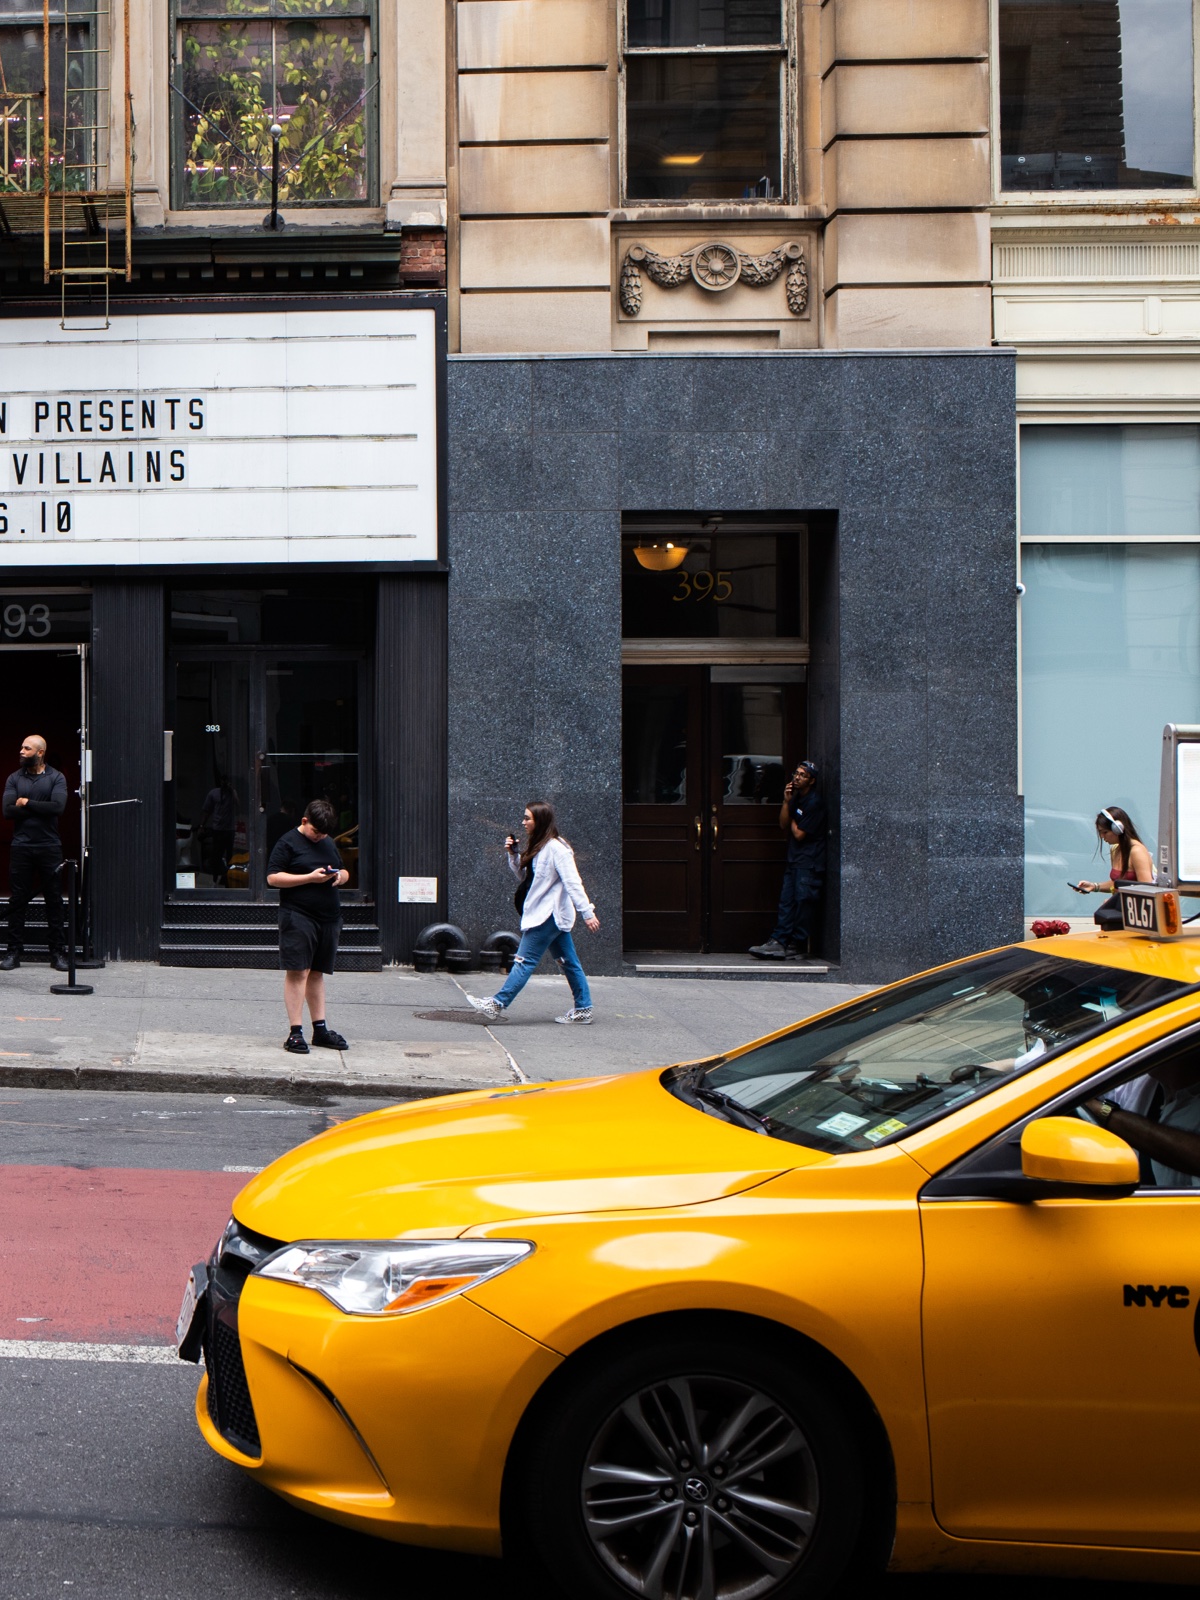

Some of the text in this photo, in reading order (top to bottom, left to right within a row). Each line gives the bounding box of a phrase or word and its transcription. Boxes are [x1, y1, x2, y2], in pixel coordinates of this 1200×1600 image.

[34, 398, 205, 433] PRESENTS
[12, 449, 186, 485] VILLAINS
[672, 570, 733, 602] 395
[205, 724, 221, 733] 393
[1126, 896, 1154, 928] 8L67
[1122, 1284, 1190, 1309] NYC
